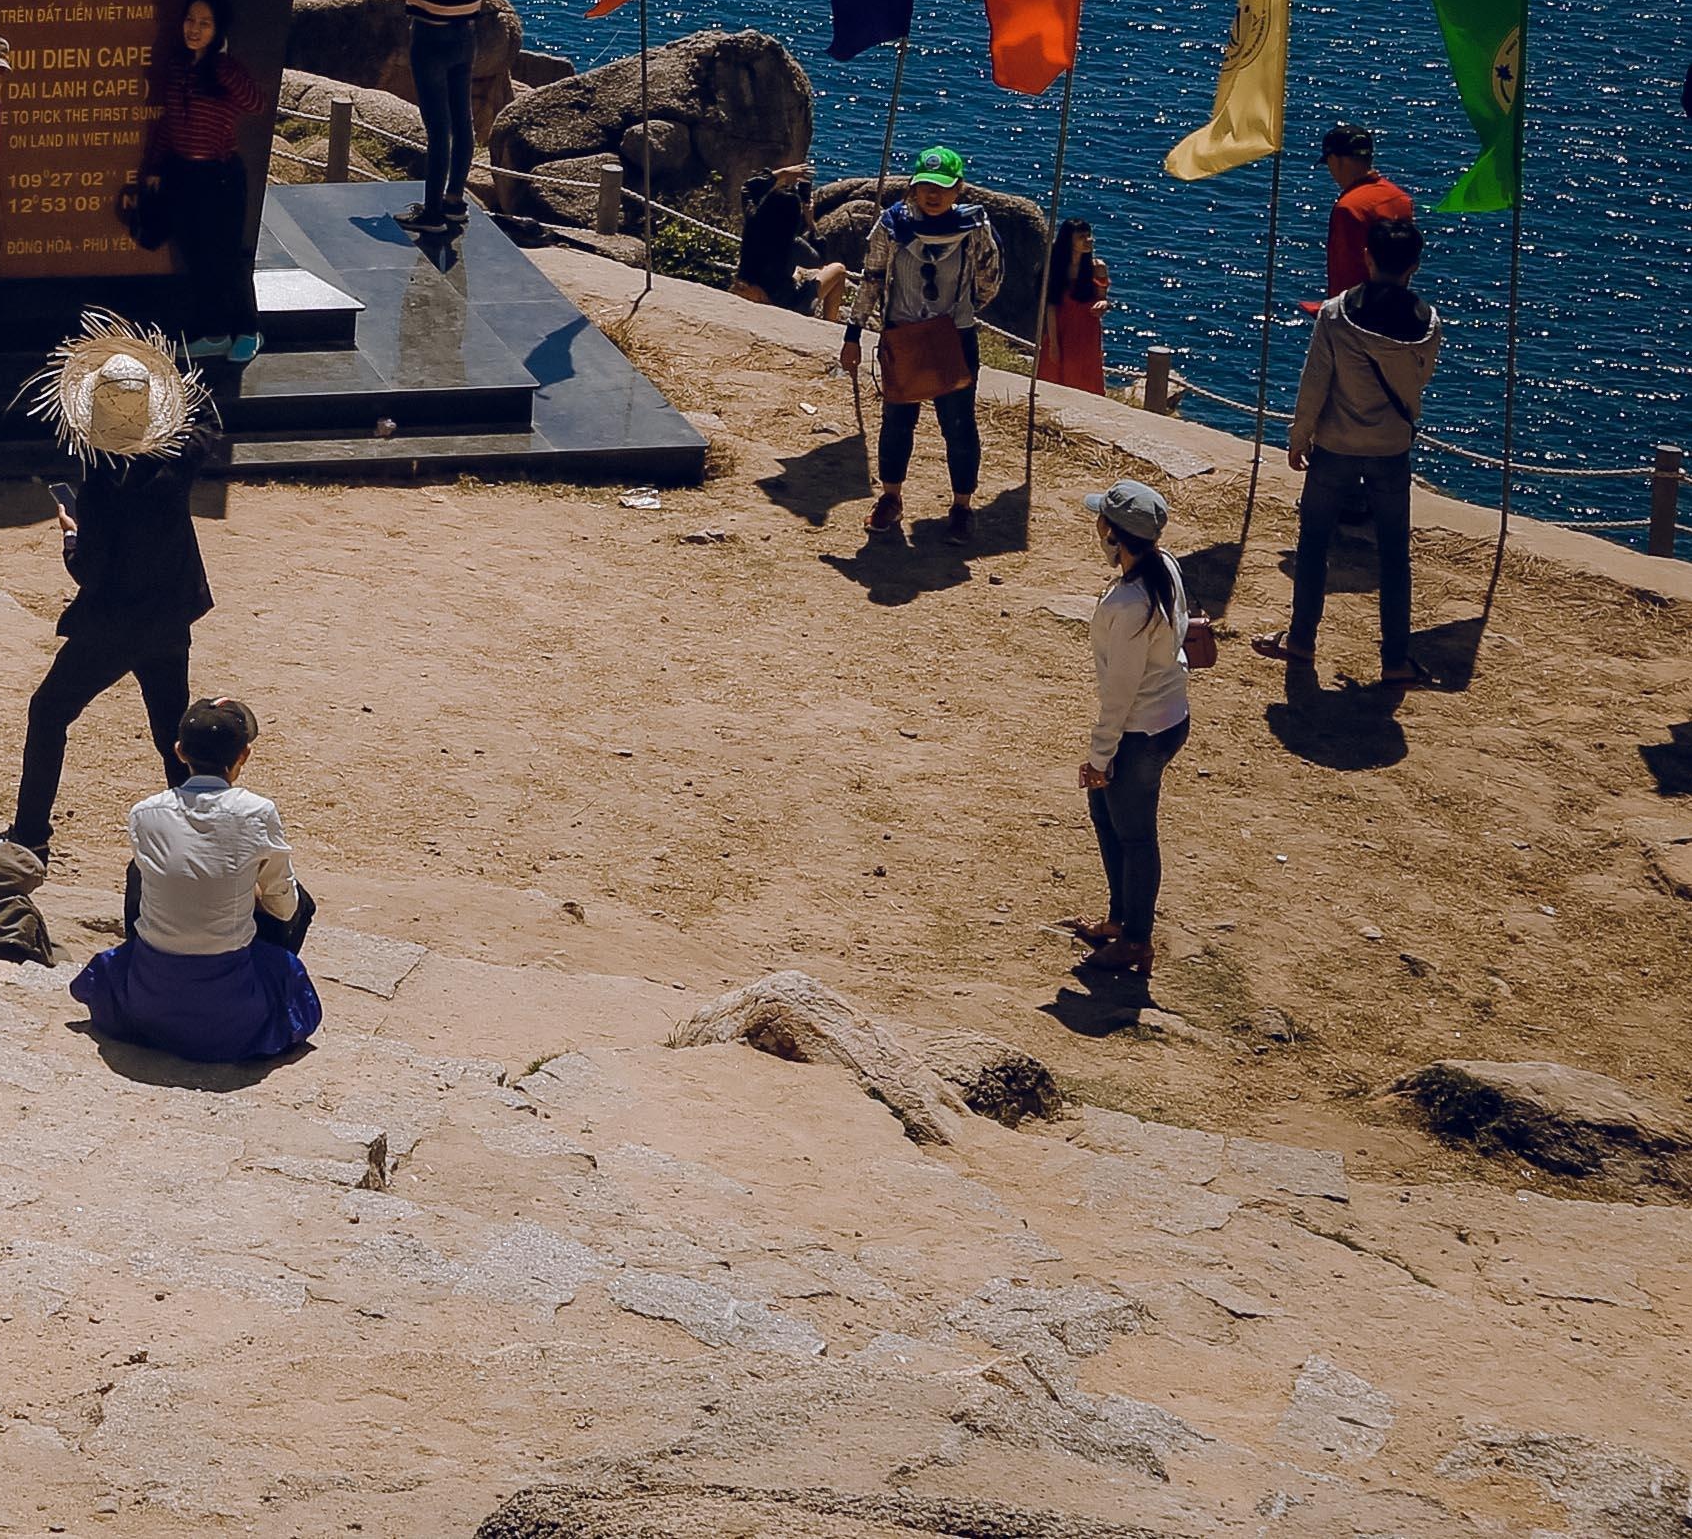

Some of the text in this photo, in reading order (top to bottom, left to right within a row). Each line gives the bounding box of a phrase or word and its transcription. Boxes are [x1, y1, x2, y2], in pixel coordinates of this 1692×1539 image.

[0, 5, 34, 24] TRÊN
[127, 5, 154, 20] NAM
[43, 47, 91, 70] DIEN
[97, 46, 152, 68] CAPE
[8, 82, 36, 100] DAI
[42, 80, 88, 99] LANH
[93, 78, 139, 97] CAPE
[12, 110, 30, 125] TO
[32, 109, 61, 124] PICK
[65, 108, 89, 123] THE
[92, 106, 129, 122] FIRST
[9, 131, 141, 149] ON LAND IN VIET NAM
[125, 169, 138, 185] E
[123, 194, 138, 210] N
